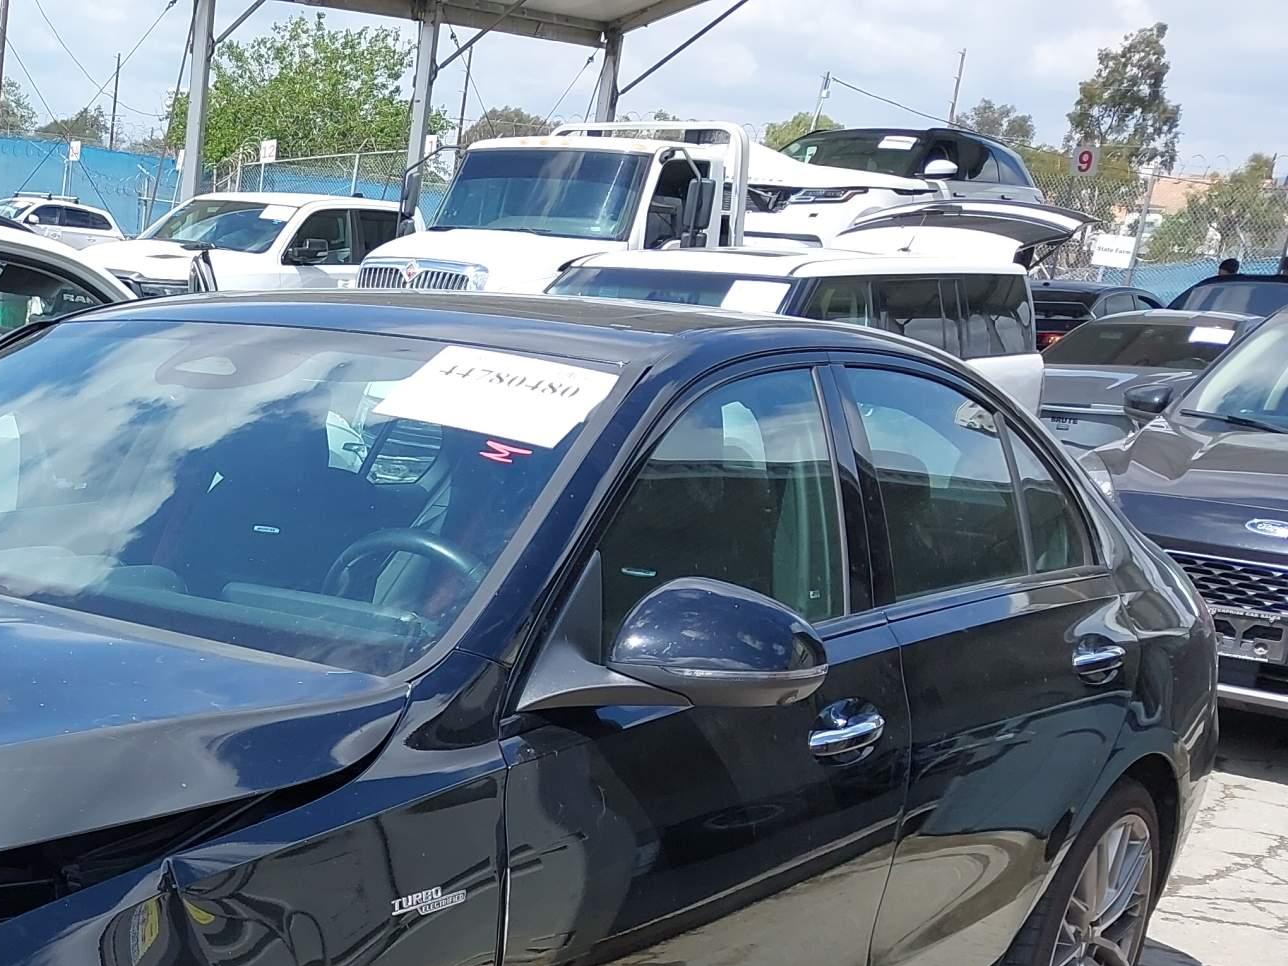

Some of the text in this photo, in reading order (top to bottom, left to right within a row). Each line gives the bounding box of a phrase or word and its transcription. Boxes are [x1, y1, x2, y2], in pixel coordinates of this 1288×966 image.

[262, 145, 275, 158] 12
[1077, 150, 1093, 173] 9
[440, 365, 580, 398] 44780480
[391, 886, 442, 912] TURBO
